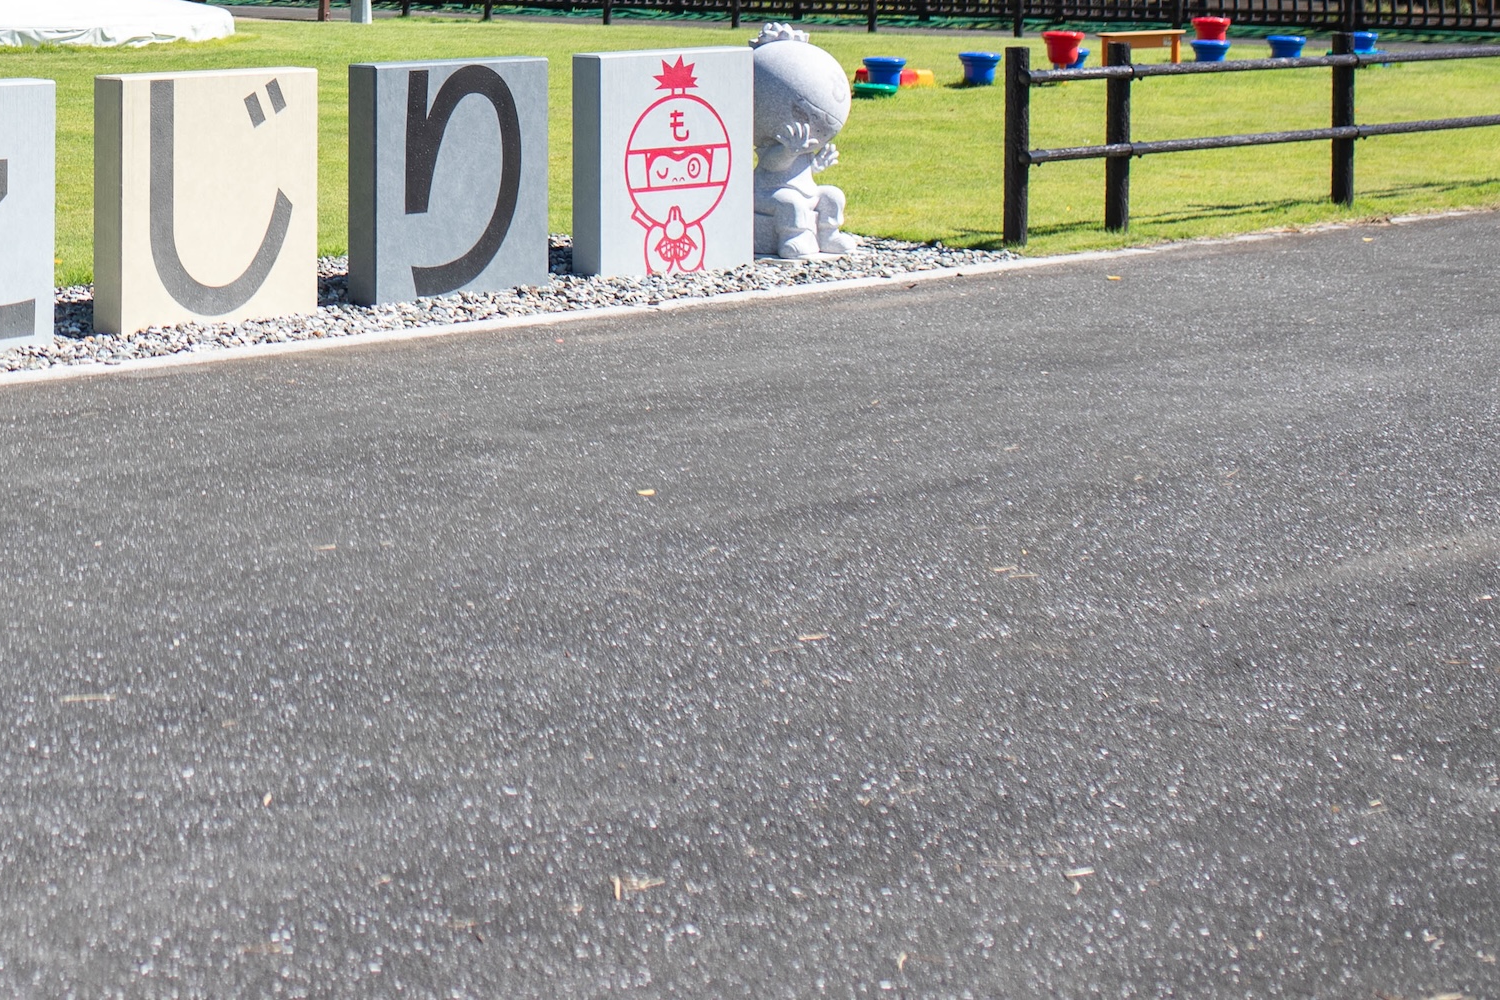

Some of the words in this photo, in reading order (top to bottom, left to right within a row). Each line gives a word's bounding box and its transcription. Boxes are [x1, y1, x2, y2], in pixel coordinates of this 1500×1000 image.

[150, 78, 293, 316] じ
[405, 65, 522, 297] り
[670, 110, 689, 141] も
